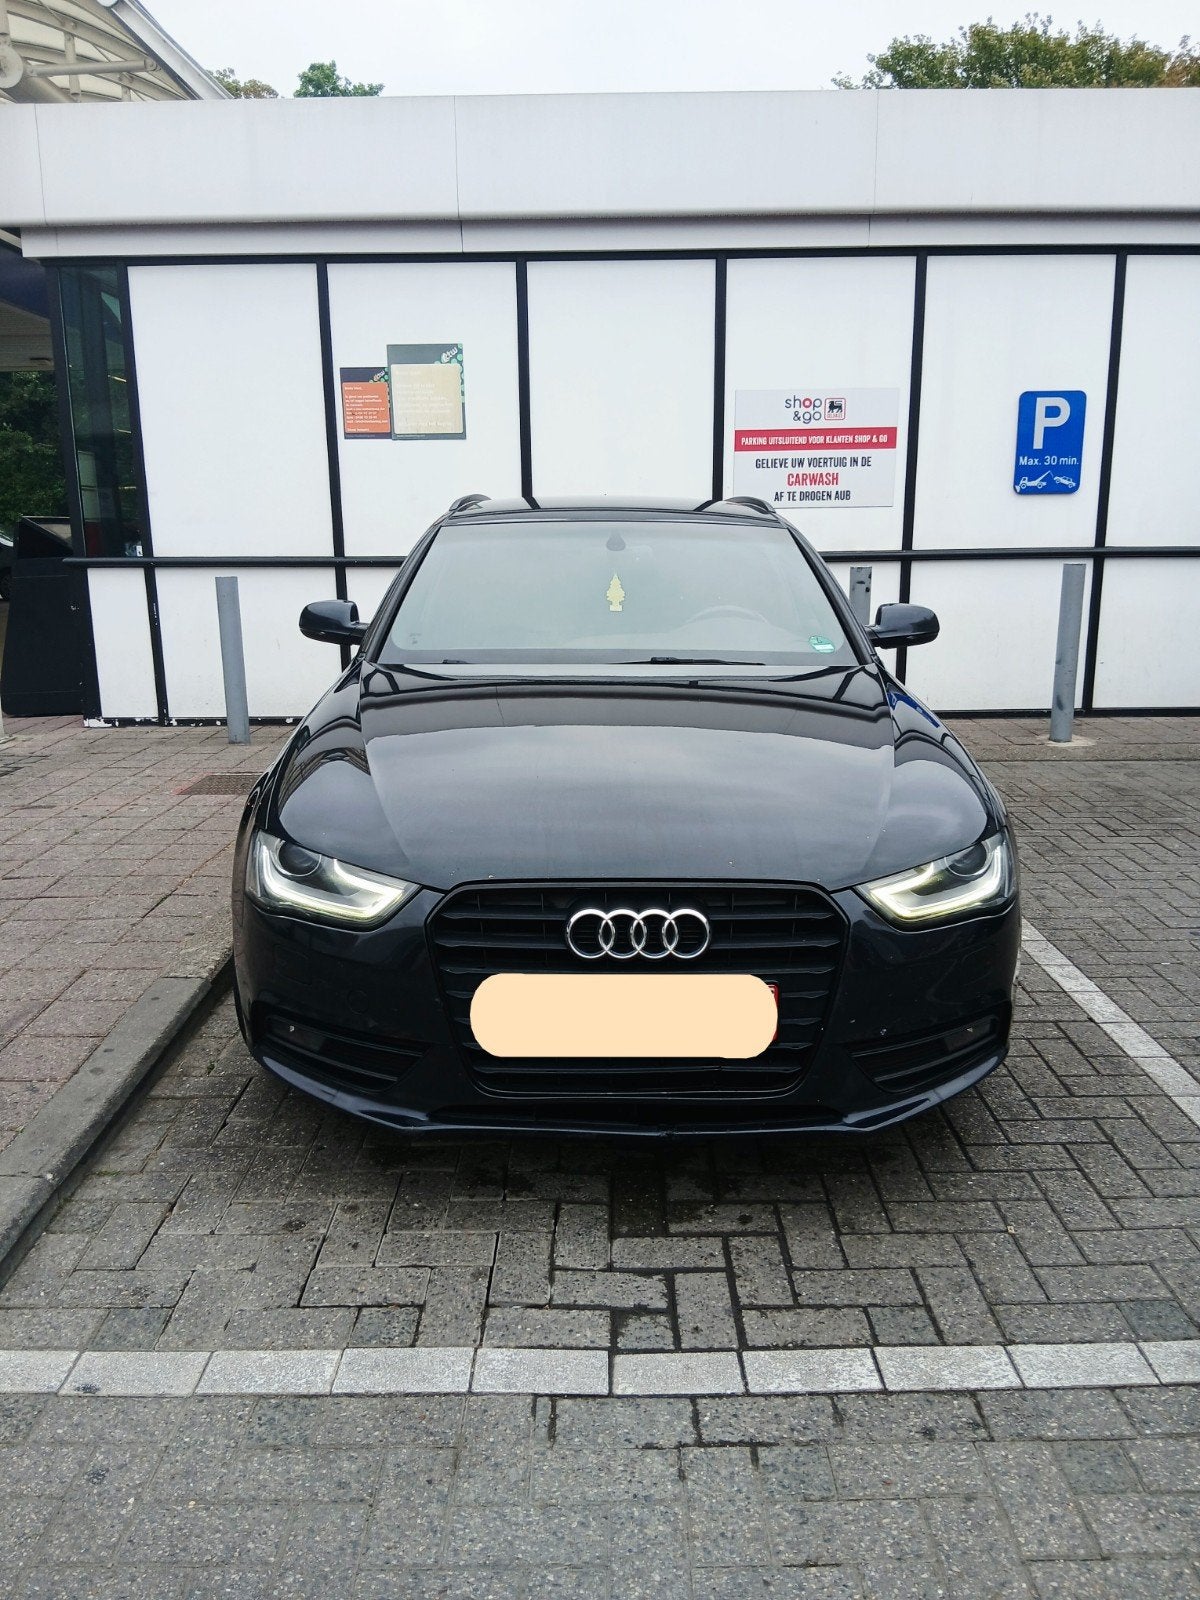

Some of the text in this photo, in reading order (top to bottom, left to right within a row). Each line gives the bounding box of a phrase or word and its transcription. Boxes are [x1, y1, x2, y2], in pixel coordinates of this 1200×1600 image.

[784, 395, 822, 411] shop
[1033, 397, 1070, 449] P
[741, 434, 888, 446] PARKING UITSLUITEND VOOR KLANTEN SHOP & GO
[755, 456, 872, 469] GELIEVE UW VOERTUIG IN DE
[1018, 455, 1079, 466] Max. 30 min.
[787, 472, 839, 487] CARWASH
[773, 490, 851, 502] AF TE DROGEN AUB
